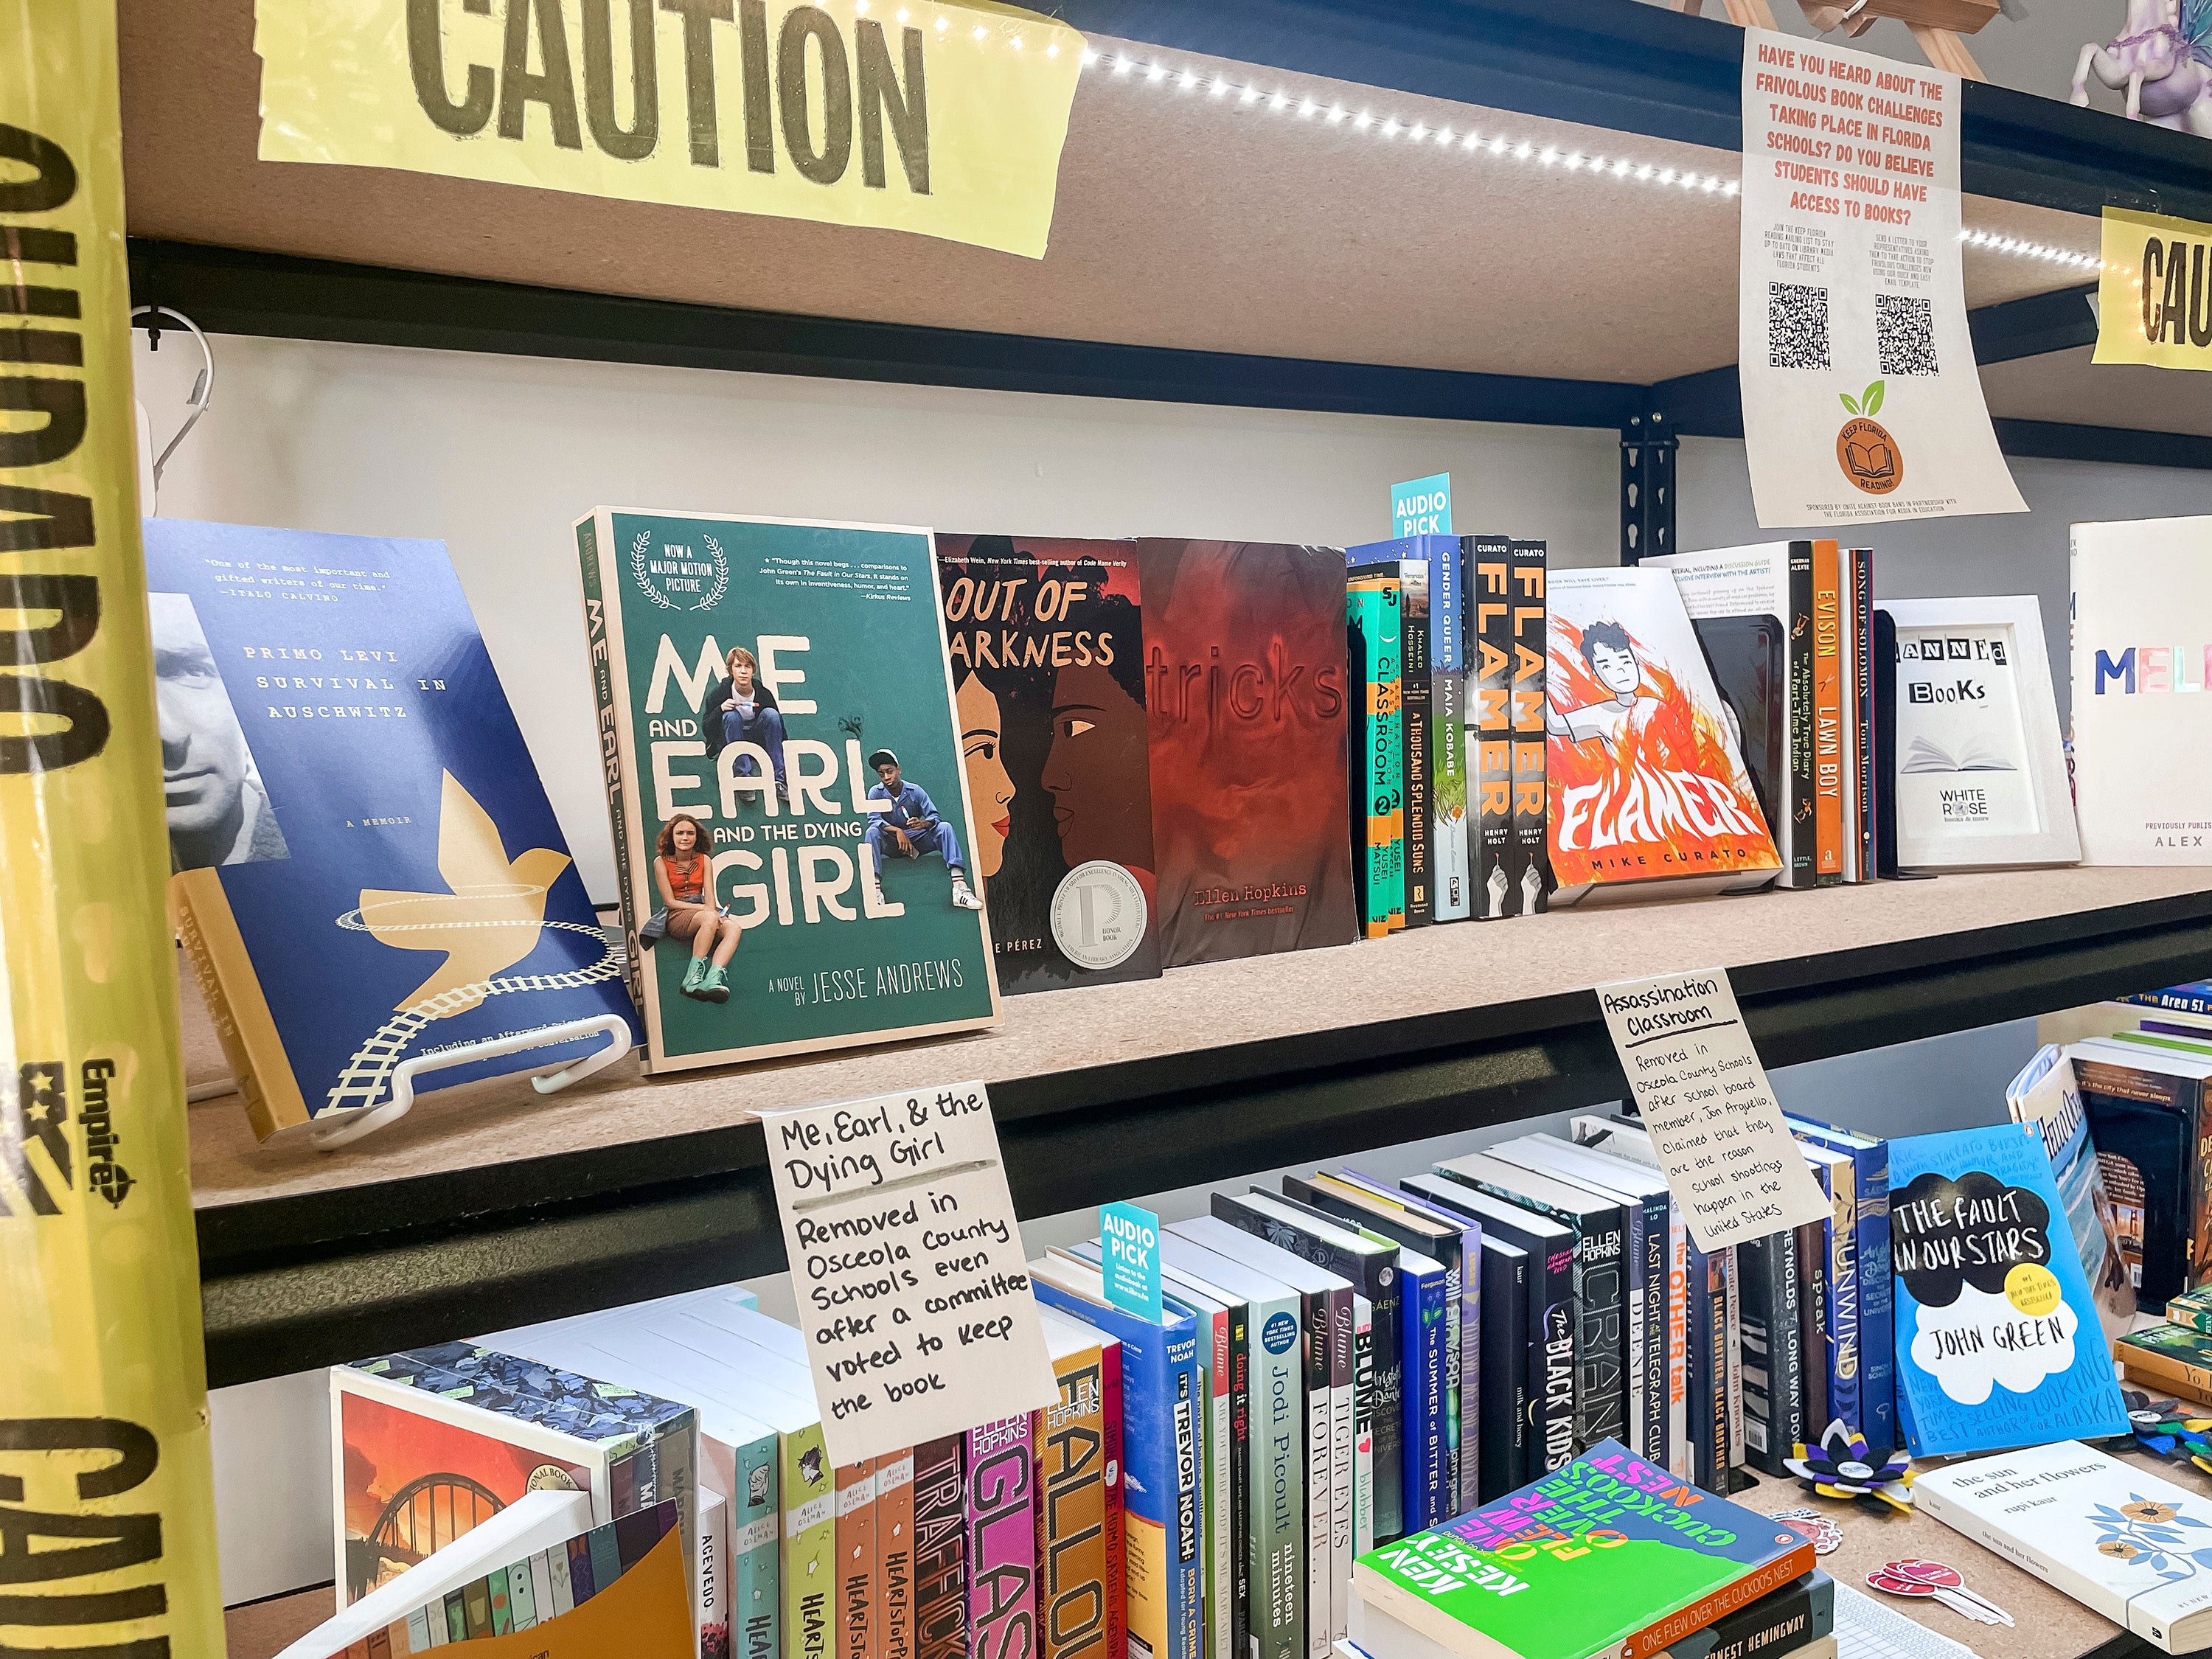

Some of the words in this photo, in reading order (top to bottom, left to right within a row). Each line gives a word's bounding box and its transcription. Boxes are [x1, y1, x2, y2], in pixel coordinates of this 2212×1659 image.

[1759, 44, 1795, 68] HAVE
[1800, 55, 1825, 74] YOU
[1829, 60, 1871, 85] HEARD
[1876, 72, 1915, 95] ABOUT
[1920, 81, 1942, 101] THE
[406, 0, 933, 196] CAUTION
[1756, 73, 1826, 102] FRIVOLOUS
[1832, 89, 1863, 110] BOOK
[1868, 97, 1942, 127] CHALLENGES
[1770, 105, 1816, 128] TAKING
[1821, 114, 1862, 137] PLACE
[1867, 123, 1878, 140] IN
[1882, 130, 1930, 151] FLORIDA
[1767, 132, 1831, 159] SCHOOLS?
[1836, 145, 1852, 163] DO
[1857, 149, 1881, 168] YOU
[1885, 155, 1933, 177] BELIEVE
[1775, 161, 1838, 188] STUDENTS
[1843, 175, 1889, 196] SHOULD
[1894, 186, 1927, 201] HAVE
[1790, 192, 1839, 215] ACCESS
[1844, 201, 1860, 218] TO
[1865, 204, 1910, 225] BOOKS?
[1396, 491, 1446, 518] AUDIO
[1403, 515, 1439, 538] PICK
[238, 560, 251, 569] of
[257, 561, 276, 570] the
[282, 563, 307, 573] most
[313, 565, 366, 577] important
[372, 570, 390, 579] and
[650, 560, 678, 575] MAJOR
[681, 562, 712, 576] MOTION
[664, 544, 683, 557] NOW
[686, 546, 692, 558] A
[282, 591, 338, 602] CALVINO
[667, 578, 701, 593] PICTURE
[945, 577, 1026, 622] OUT
[1034, 579, 1087, 622] OF
[1441, 552, 1450, 610] GENDER
[1857, 561, 1865, 601] SONG
[1818, 590, 1834, 658] EVISON
[1857, 604, 1865, 625] OF
[243, 647, 322, 661] PRIMO
[339, 650, 398, 663] LEVI
[950, 630, 1114, 668] ARKNESS
[1443, 615, 1452, 663] QUEER
[256, 676, 394, 690] SURVIVAL
[417, 679, 446, 691] IN
[645, 633, 817, 714] ME
[1147, 644, 1342, 723] tricks
[1857, 628, 1868, 698] SOLOMON
[268, 706, 407, 719] AUSCHWITZ
[1478, 563, 1511, 817] FLAMER
[649, 719, 698, 737] AND
[1445, 723, 1455, 776] KOBABE
[1818, 708, 1837, 758] LAWN
[650, 740, 893, 822] EARL
[1558, 749, 1765, 852] FLAMER
[1818, 762, 1837, 799] BOY
[1940, 789, 1985, 801] WHITE
[714, 826, 756, 843] AND
[761, 824, 799, 841] THE
[804, 821, 863, 839] DYING
[1592, 856, 1646, 869] MIKE
[1664, 849, 1747, 862] CURATO
[712, 843, 905, 931] GIRL
[1194, 888, 1239, 906] Ellen
[1244, 883, 1307, 902] Hopkins
[812, 968, 866, 1004] JESSE
[877, 959, 964, 996] ANDREWS
[1604, 978, 1718, 1013] Assassination
[1627, 1005, 1712, 1036] Classroom
[1636, 1049, 1688, 1071] Removed
[1696, 1043, 1708, 1055] in
[1636, 1074, 1677, 1093] Osceola
[1680, 1067, 1717, 1079] County
[1718, 1055, 1752, 1072] Schools
[79, 1058, 119, 1195] Empire
[907, 1098, 928, 1126] &
[936, 1093, 983, 1116] the
[785, 1152, 883, 1192] Dying
[890, 1133, 945, 1166] Girl
[796, 1200, 917, 1249] Removed
[929, 1192, 958, 1215] in
[1103, 1213, 1155, 1249] AUDIO
[1893, 1200, 1952, 1236] THE
[1957, 1189, 2021, 1228] FAULT
[807, 1244, 911, 1279] Osceola
[1111, 1237, 1150, 1270] PICK
[1648, 1233, 1659, 1270] LAST
[1676, 1242, 1685, 1265] the
[1894, 1242, 1919, 1272] IN
[1921, 1245, 1966, 1270] OUR
[1967, 1227, 2044, 1267] STARS
[812, 1269, 918, 1310] Schools
[935, 1252, 988, 1276] even
[1648, 1274, 1660, 1322] NIGHT
[1812, 1269, 1823, 1334] speak
[817, 1314, 877, 1344] after
[893, 1310, 911, 1324] a
[925, 1273, 1029, 1313] committee
[1669, 1271, 1685, 1359] OTHER
[1837, 1239, 1858, 1380] UNWIND
[827, 1342, 902, 1382] voted
[917, 1333, 943, 1355] to
[1166, 1338, 1196, 1354] TREVOR
[1170, 1351, 1194, 1363] NOAH
[1930, 1326, 1985, 1360] JOHN
[1993, 1315, 2065, 1349] GREEN
[832, 1392, 872, 1420] the
[883, 1373, 945, 1402] book
[1272, 1366, 1289, 1426] Jodi
[1545, 1338, 1572, 1412] BLACK
[1648, 1335, 1661, 1421] TELEGRAPH
[1671, 1363, 1685, 1405] talk
[1334, 1398, 1349, 1480] TIGER
[1546, 1417, 1572, 1471] KIDS
[1648, 1423, 1661, 1461] CLUB
[1274, 1435, 1290, 1533] Picoult
[1952, 1475, 1983, 1489] the
[1985, 1467, 2018, 1481] sun
[1975, 1483, 2010, 1499] and
[2006, 1477, 2041, 1489] her
[2039, 1461, 2107, 1483] flowers
[1334, 1484, 1349, 1548] EYES
[2004, 1500, 2031, 1514] rupi
[2028, 1496, 2056, 1506] kaur
[702, 1534, 713, 1608] ACEVEDO
[1272, 1551, 1281, 1628] minutes
[1284, 1544, 1294, 1624] nineteen
[1642, 1629, 1663, 1651] ONE
[1665, 1615, 1689, 1639] FLEW
[1690, 1602, 1712, 1626] OVER
[1714, 1593, 1731, 1614] THE
[1774, 1559, 1794, 1580] NEST
[1747, 1613, 1805, 1652] HEMINGWAY
